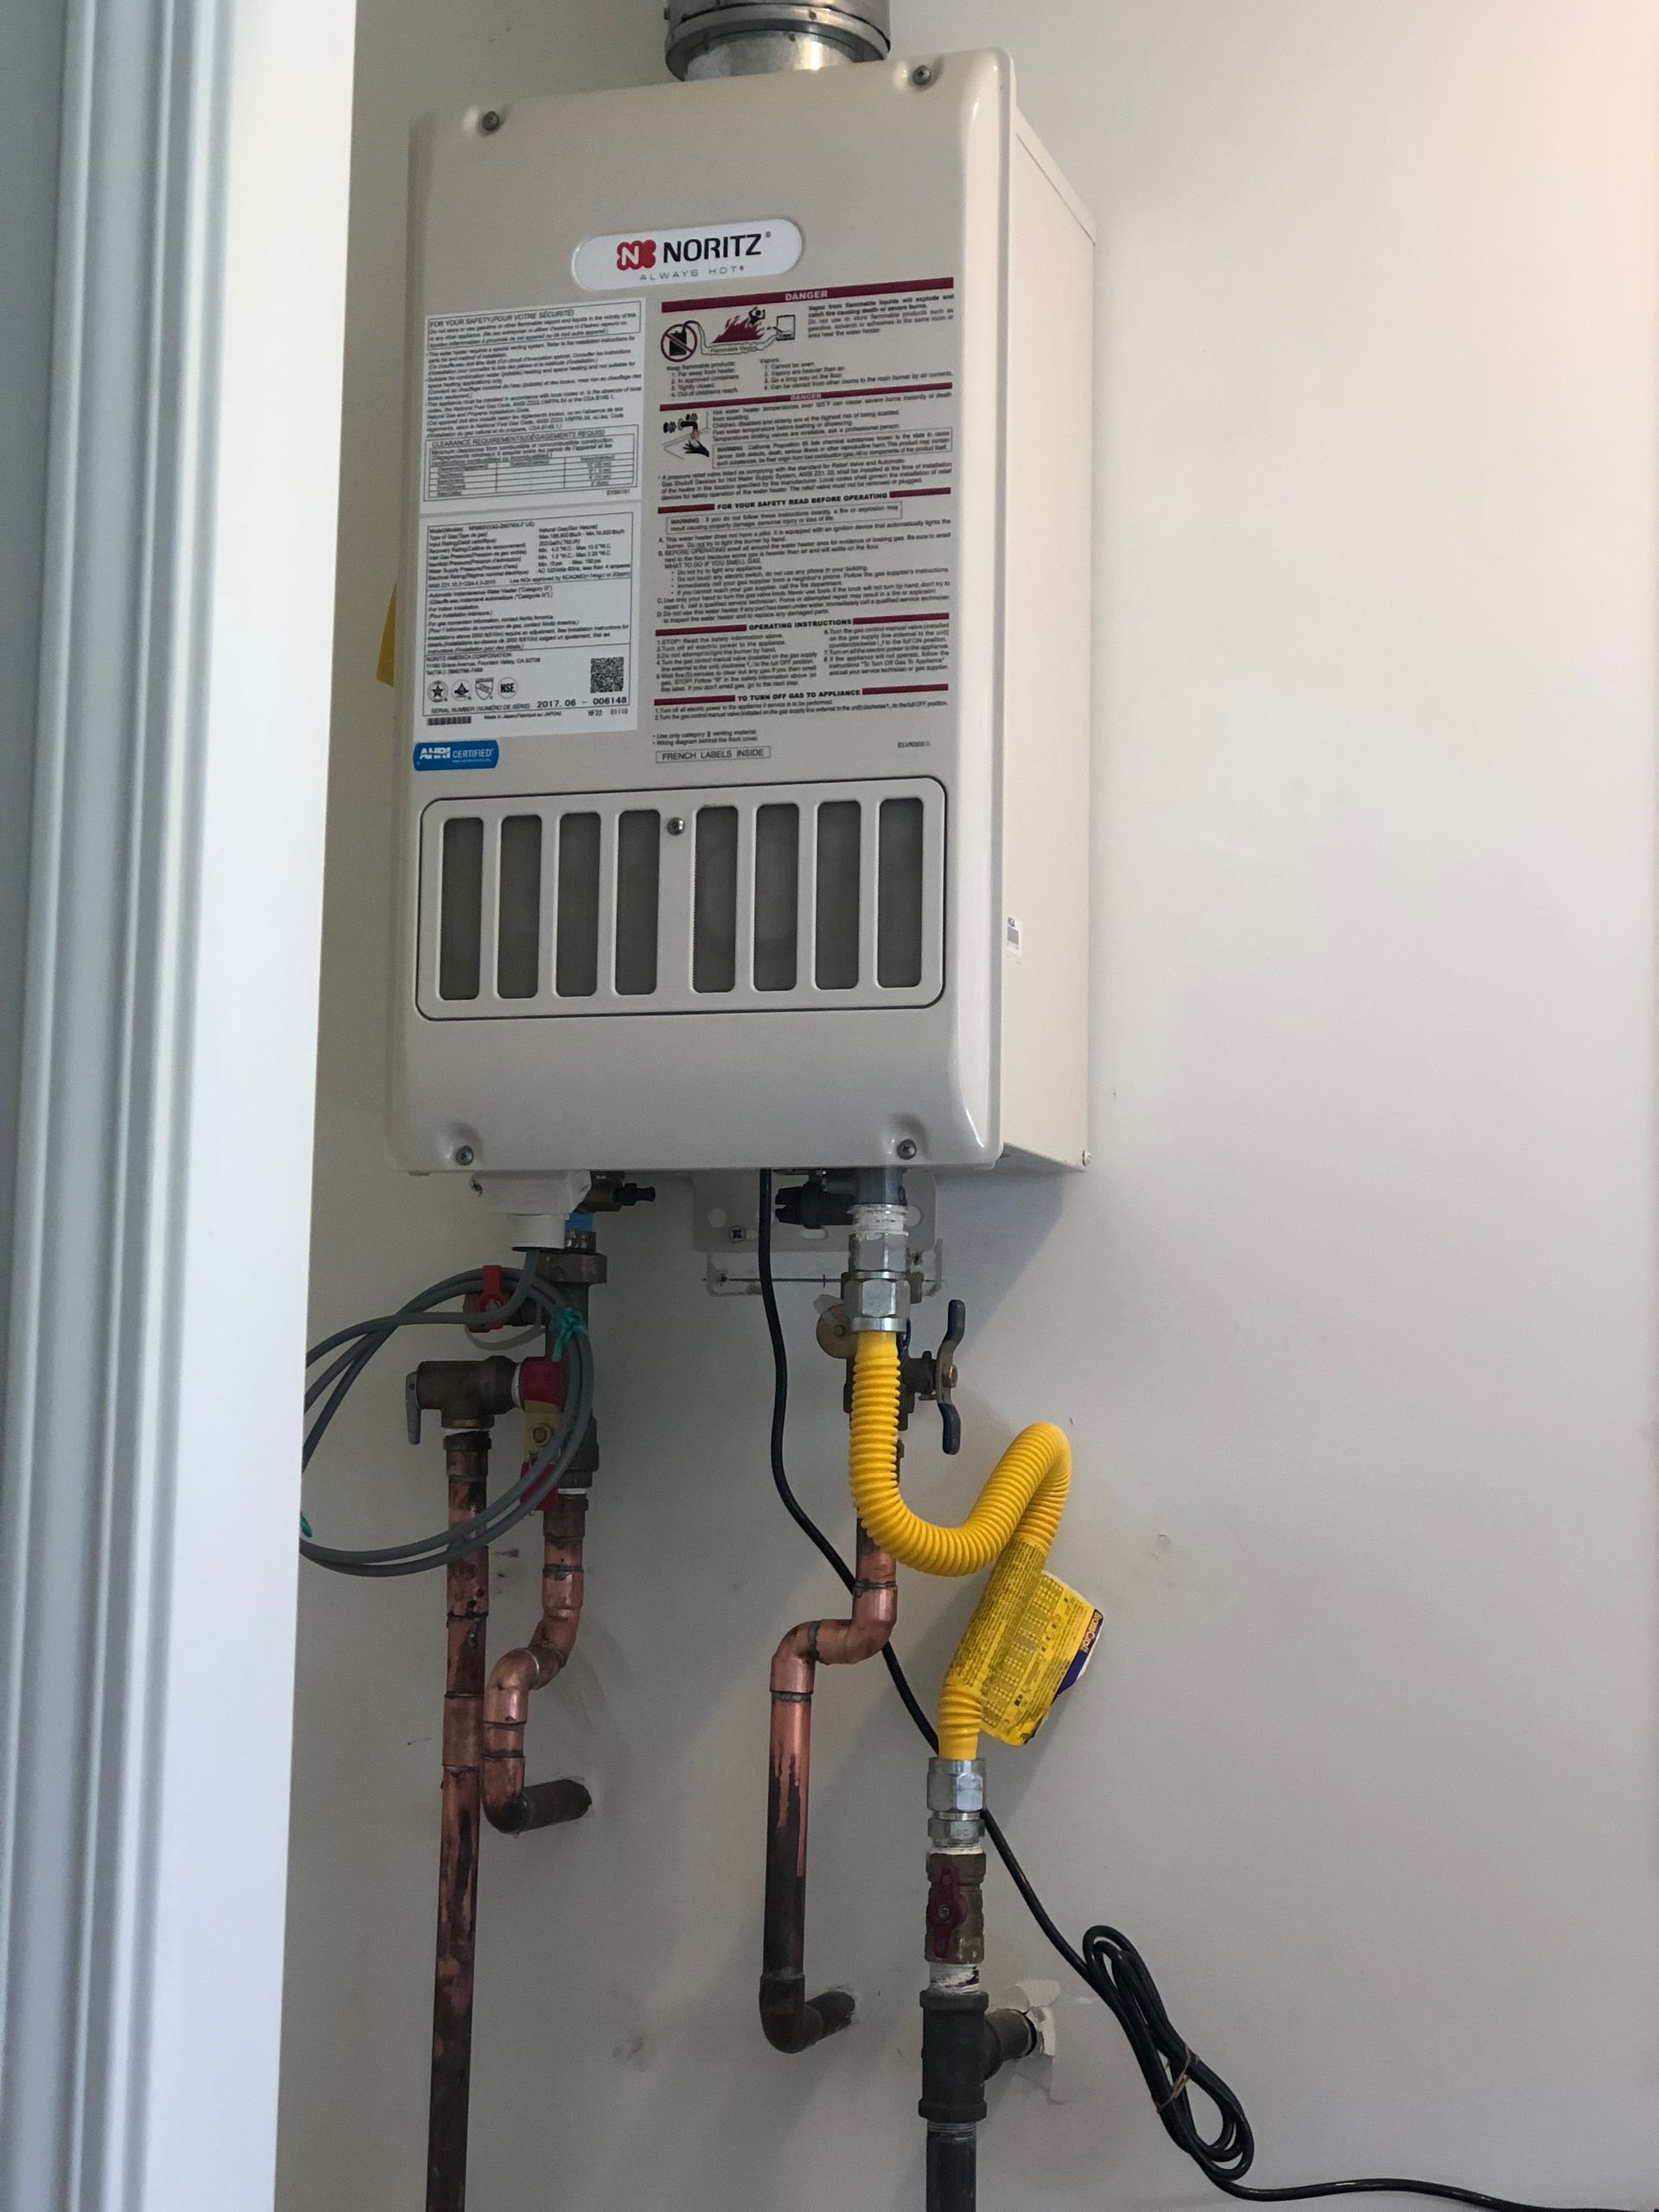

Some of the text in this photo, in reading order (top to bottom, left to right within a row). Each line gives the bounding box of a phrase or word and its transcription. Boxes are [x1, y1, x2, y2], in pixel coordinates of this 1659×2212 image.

[663, 233, 762, 263] NORITZ
[639, 265, 740, 281] ALWAYS HOT
[785, 289, 829, 302] DANGER
[790, 392, 822, 401] DANGER
[843, 493, 887, 501] OPERATING
[794, 619, 851, 627] INSTRUCTIONS
[500, 683, 512, 693] NSF
[419, 747, 492, 760] AHRI CERTIFIED
[662, 748, 764, 760] FRENCH LABELS INSIDE
